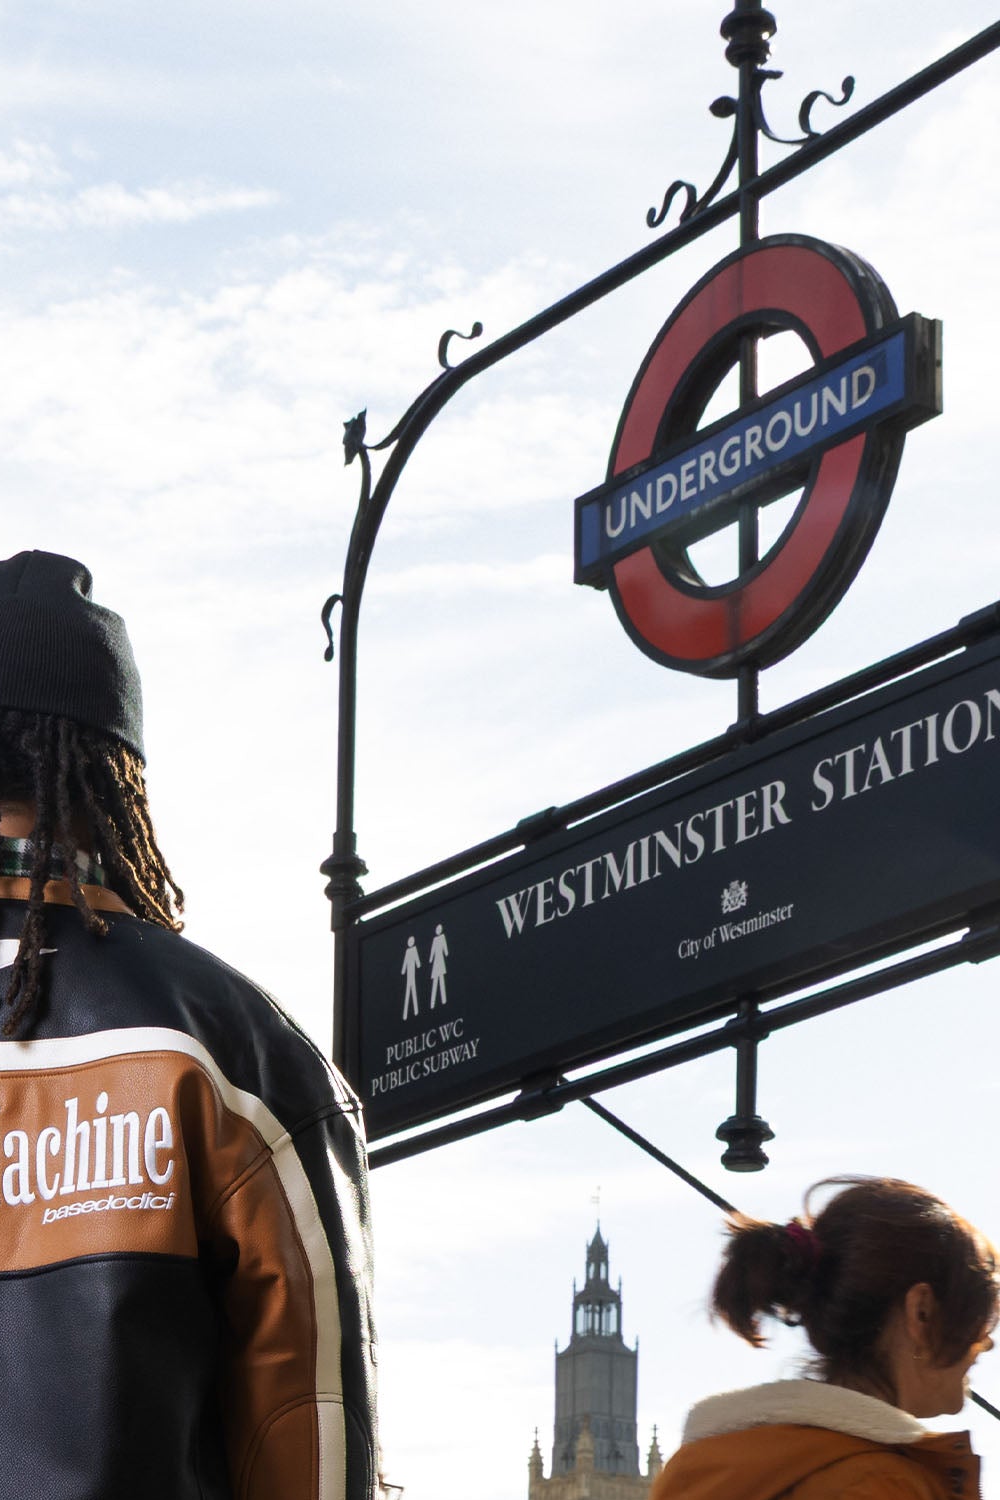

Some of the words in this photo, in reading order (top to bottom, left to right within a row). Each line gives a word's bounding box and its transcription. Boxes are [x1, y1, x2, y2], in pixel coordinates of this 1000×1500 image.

[605, 364, 876, 539] UNDERGROUND
[495, 780, 793, 939] WESTMINSTER
[678, 938, 702, 960] City
[703, 927, 717, 950] of
[719, 903, 794, 943] Westminster
[371, 1061, 422, 1097] PUBLIC
[422, 1038, 480, 1077] SUBWAY
[385, 1029, 437, 1065] PUBLIC
[438, 1018, 464, 1043] WC
[42, 1191, 176, 1225] basedodici
